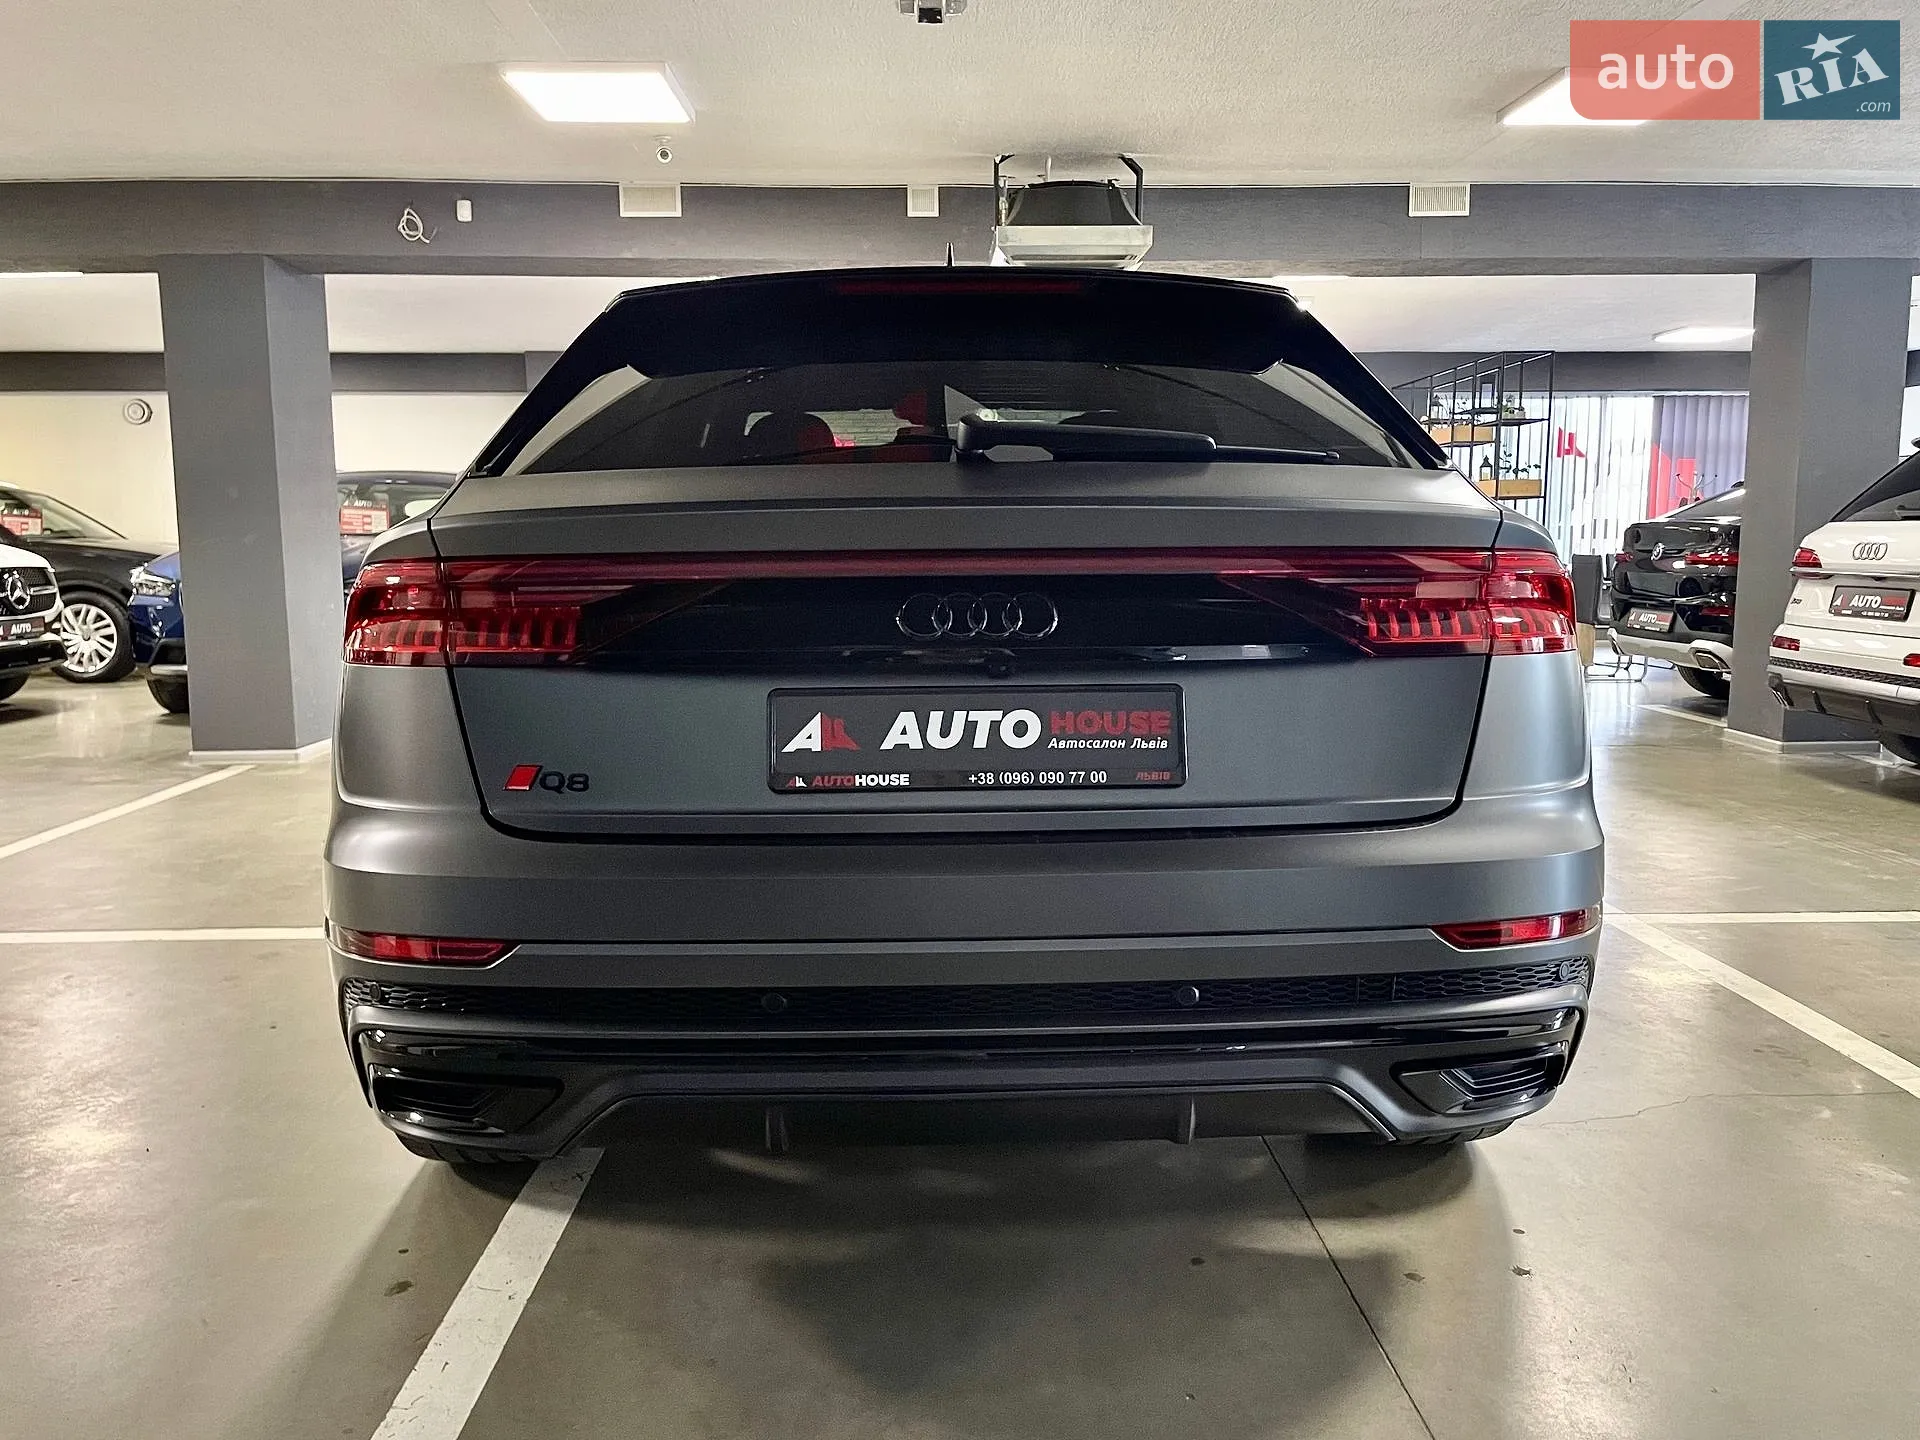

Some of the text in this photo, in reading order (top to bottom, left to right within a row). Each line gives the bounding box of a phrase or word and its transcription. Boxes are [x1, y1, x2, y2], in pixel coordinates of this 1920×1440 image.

[1849, 594, 1881, 609] AUTO
[1638, 612, 1658, 625] AUTO
[10, 622, 32, 635] AUTO
[879, 708, 1042, 750] AUTO
[1051, 710, 1171, 736] HOUSE
[1047, 736, 1168, 750] Автосалон Львів
[539, 771, 590, 794] Q8
[968, 772, 995, 785] +38
[999, 771, 1035, 785] (096)
[1038, 771, 1065, 784] 090
[1068, 771, 1086, 784] 77
[1089, 771, 1108, 784] 00
